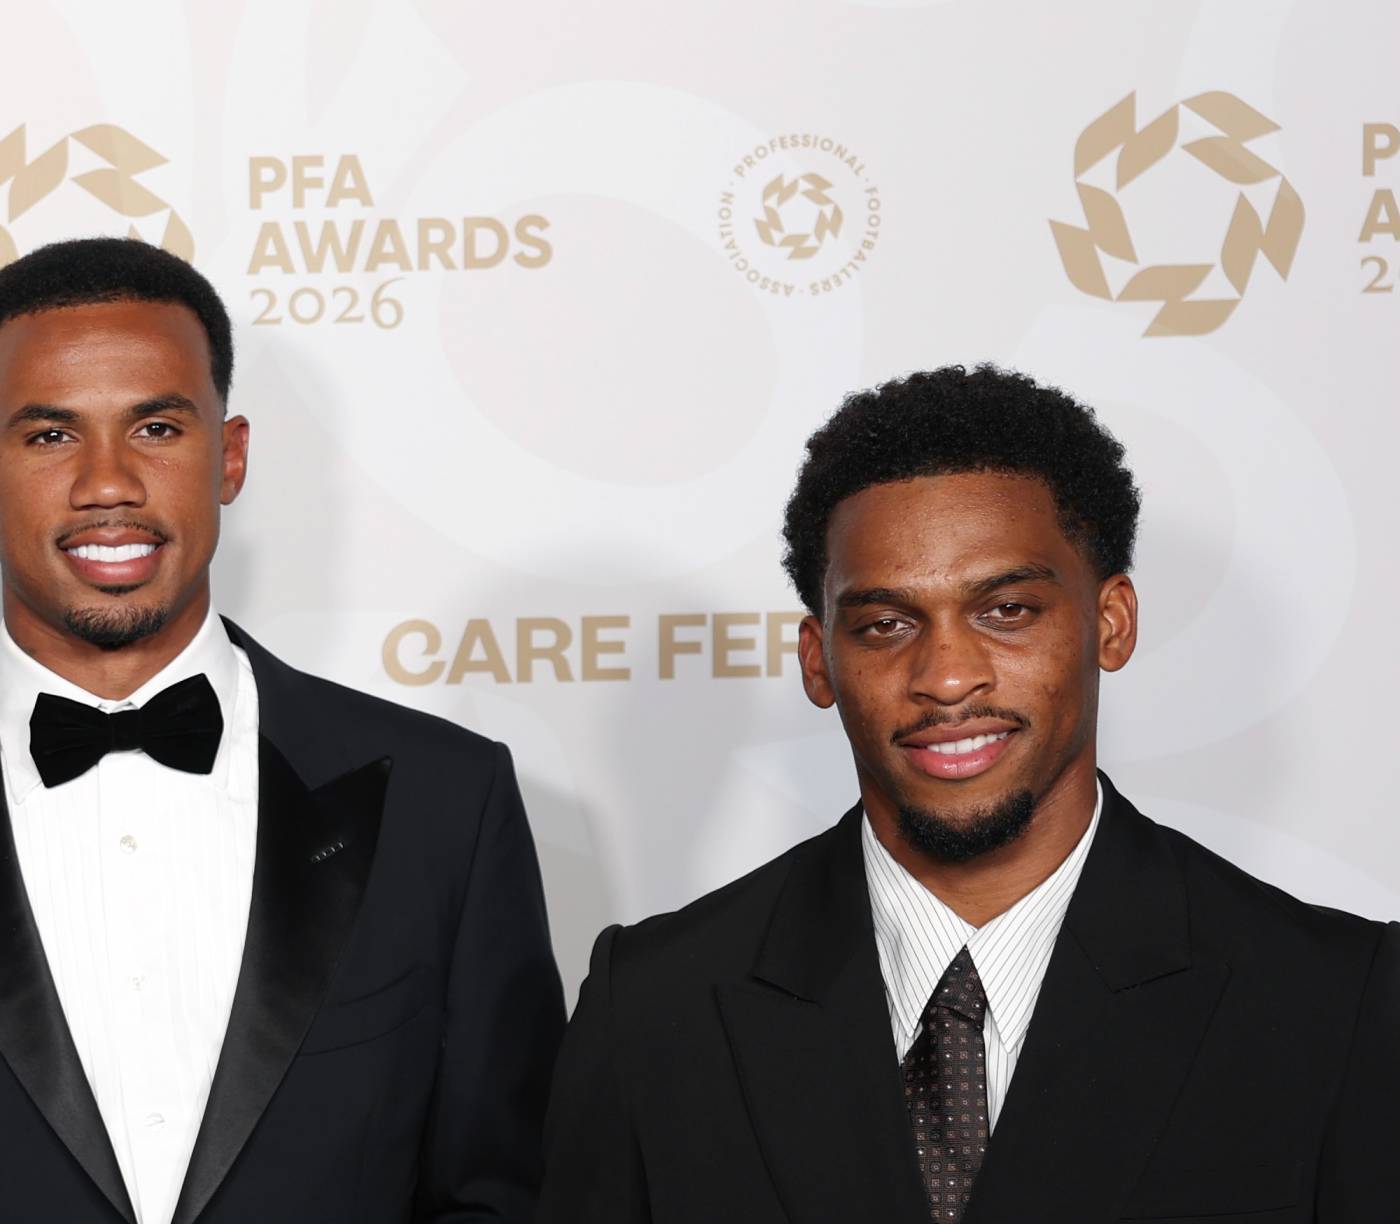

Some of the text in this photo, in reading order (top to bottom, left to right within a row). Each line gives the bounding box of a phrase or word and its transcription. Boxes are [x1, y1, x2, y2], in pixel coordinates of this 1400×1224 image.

[247, 154, 374, 209] PFA
[246, 214, 553, 275] AWARDS
[719, 134, 881, 296] PROFESSIONAL FOOTBALLERS ASSOCIATION
[251, 277, 406, 330] 2026
[381, 615, 631, 687] CARE
